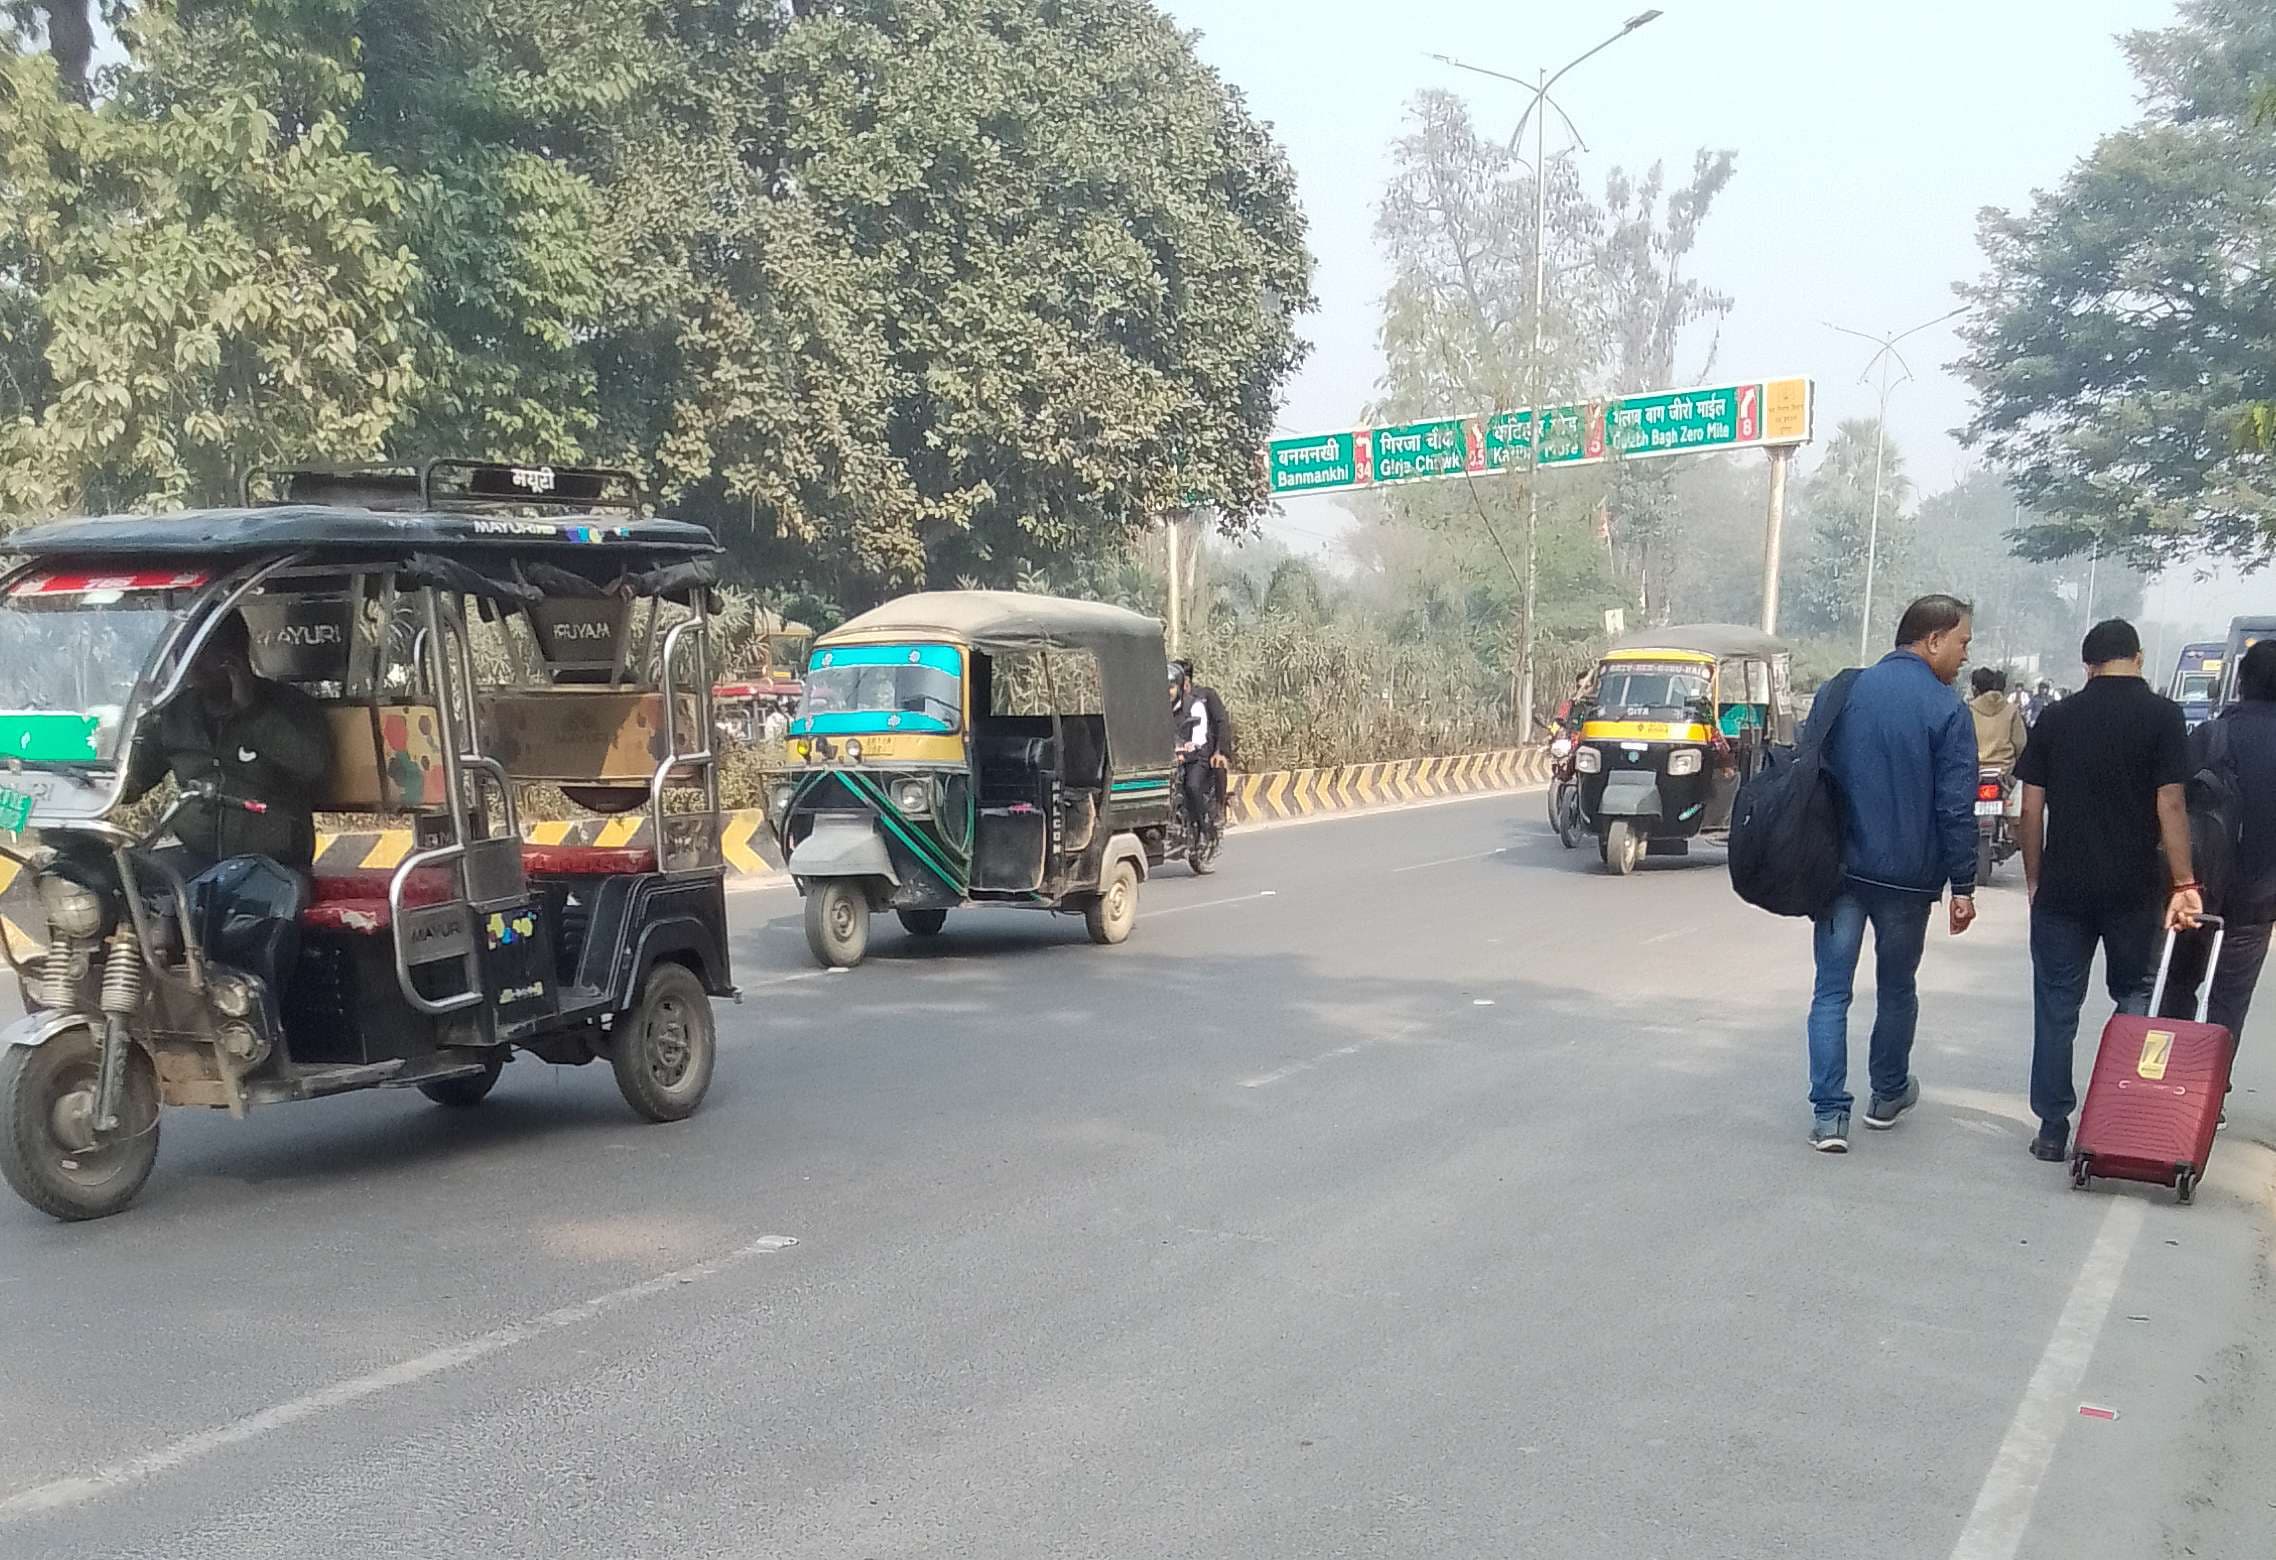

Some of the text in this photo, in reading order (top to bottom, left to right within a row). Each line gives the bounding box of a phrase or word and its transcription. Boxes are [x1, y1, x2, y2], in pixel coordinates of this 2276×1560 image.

[1668, 396, 1693, 421] जीरो
[1651, 426, 1679, 448] Bagh
[1680, 424, 1705, 443] Zero
[1706, 421, 1730, 440] Mile
[1743, 418, 1752, 437] 8
[1277, 437, 1340, 467] बनमनखी
[1379, 431, 1422, 456] गिरजा
[1415, 451, 1461, 474] Chwk
[511, 466, 555, 494] मयूरी
[1277, 463, 1349, 488] Banmankhi
